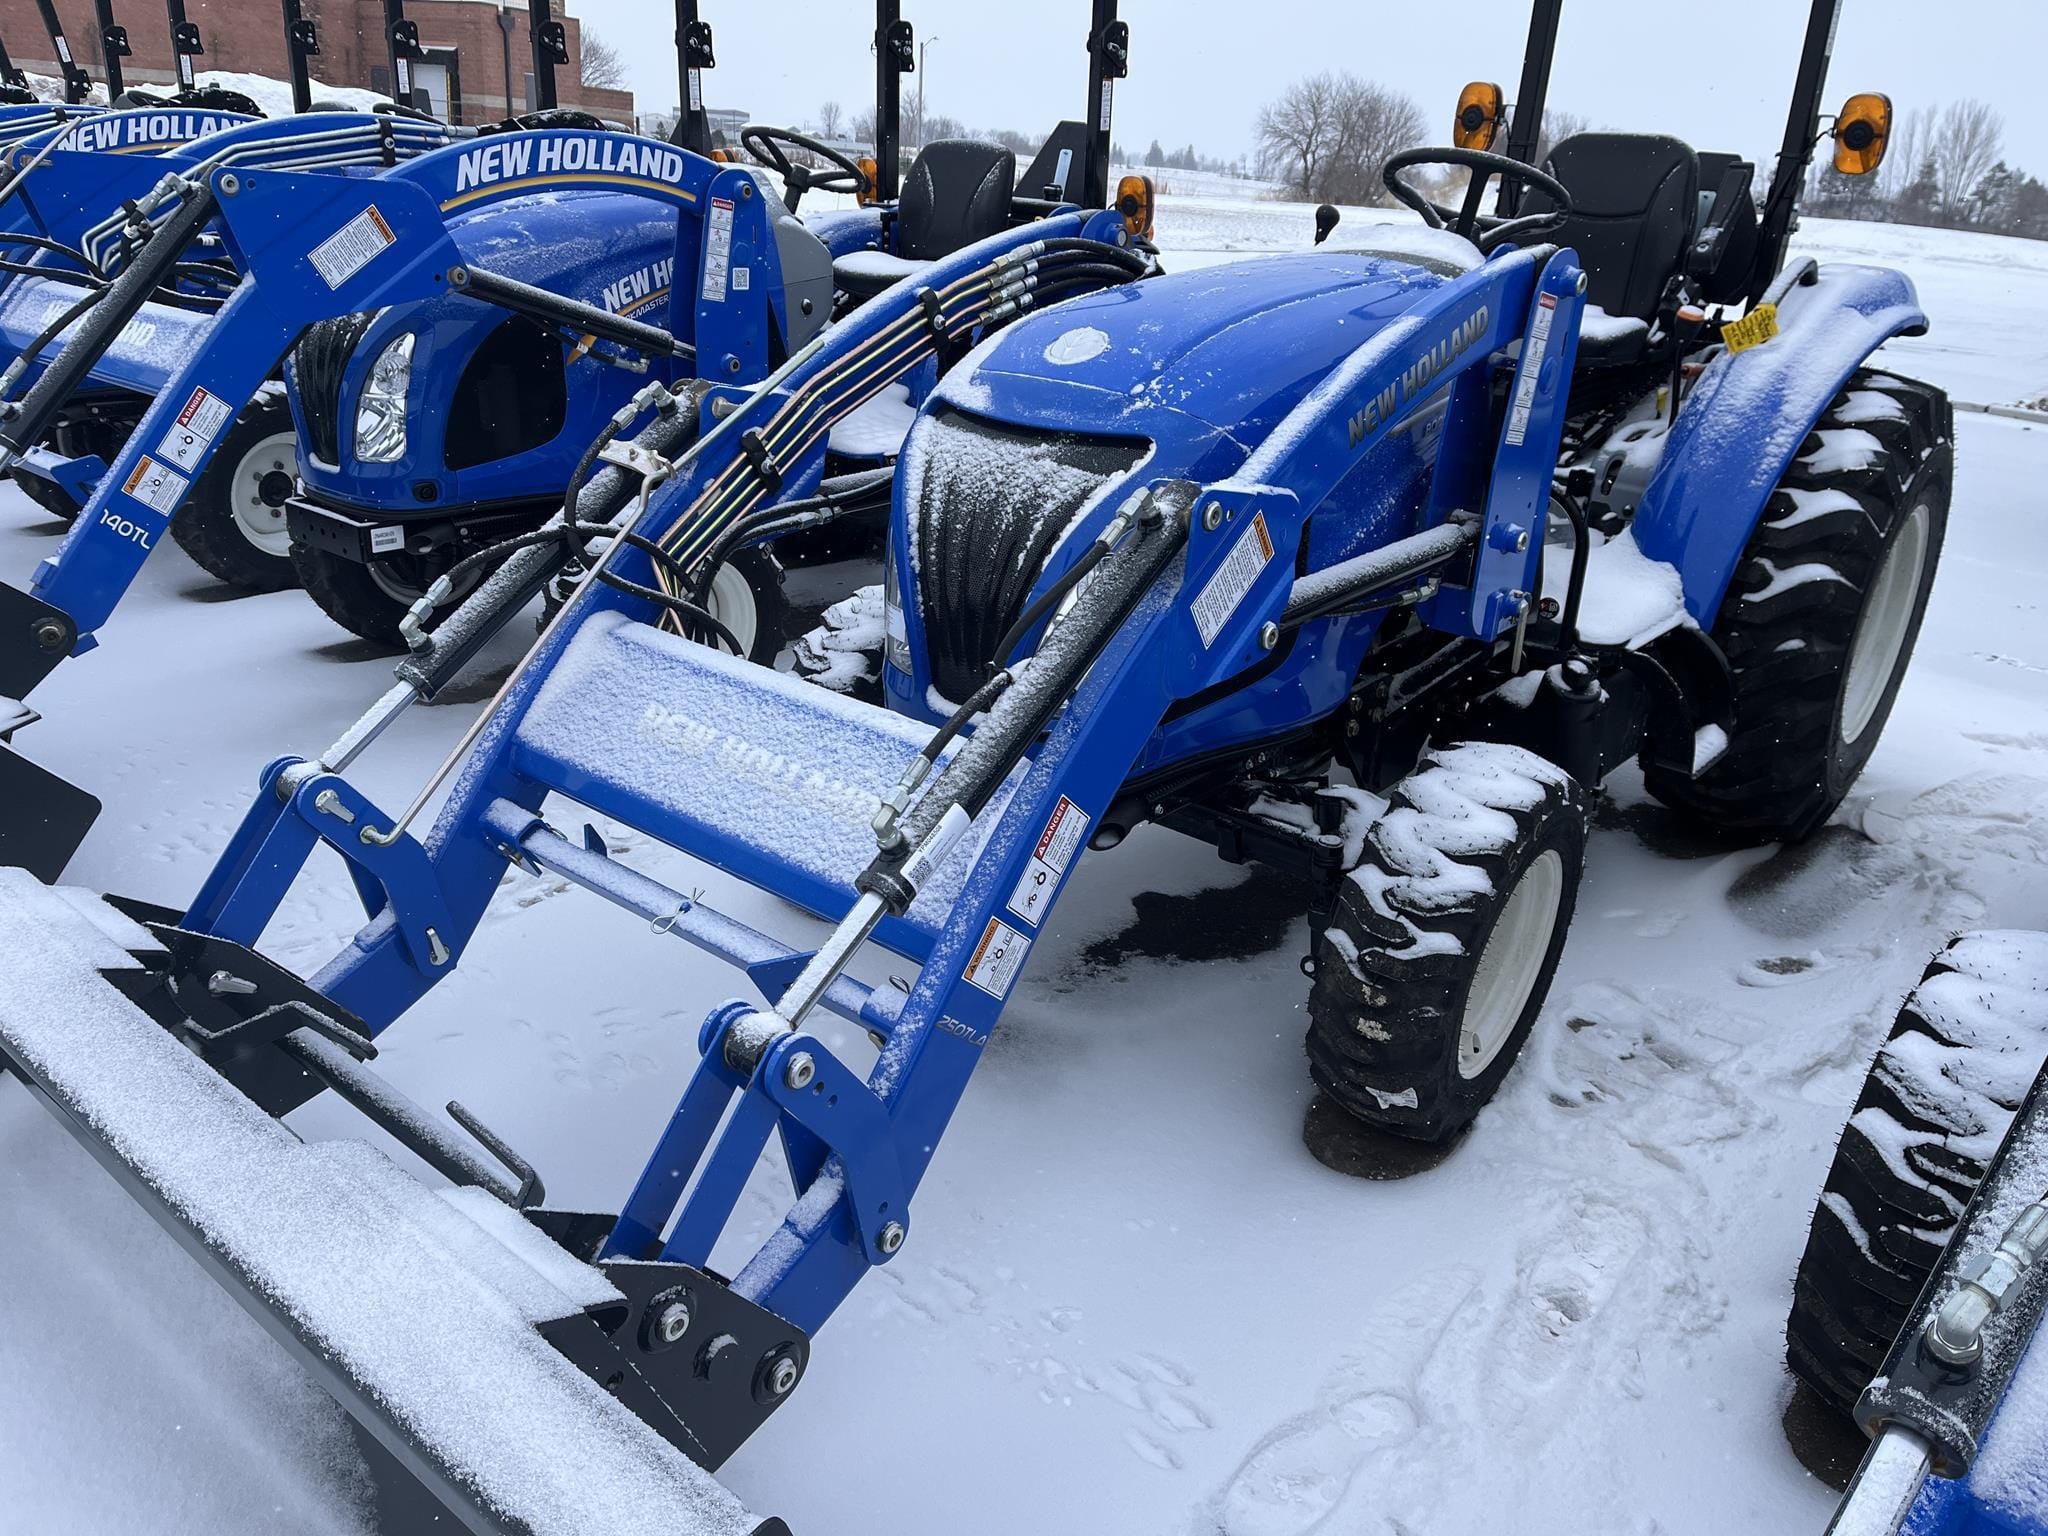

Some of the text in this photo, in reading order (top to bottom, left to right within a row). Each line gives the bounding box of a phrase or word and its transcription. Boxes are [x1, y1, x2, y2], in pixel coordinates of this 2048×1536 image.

[127, 115, 248, 143] HOLLA
[456, 137, 684, 193] NEW HOLLAND
[603, 267, 650, 313] NEW
[1347, 381, 1397, 449] NEW
[1401, 305, 1489, 403] HOLLAND
[184, 390, 205, 418] DANGER
[100, 509, 150, 550] 140TL
[1044, 802, 1066, 842] DANGER
[973, 925, 995, 961] WARNING
[937, 1014, 988, 1047] 250TLA
